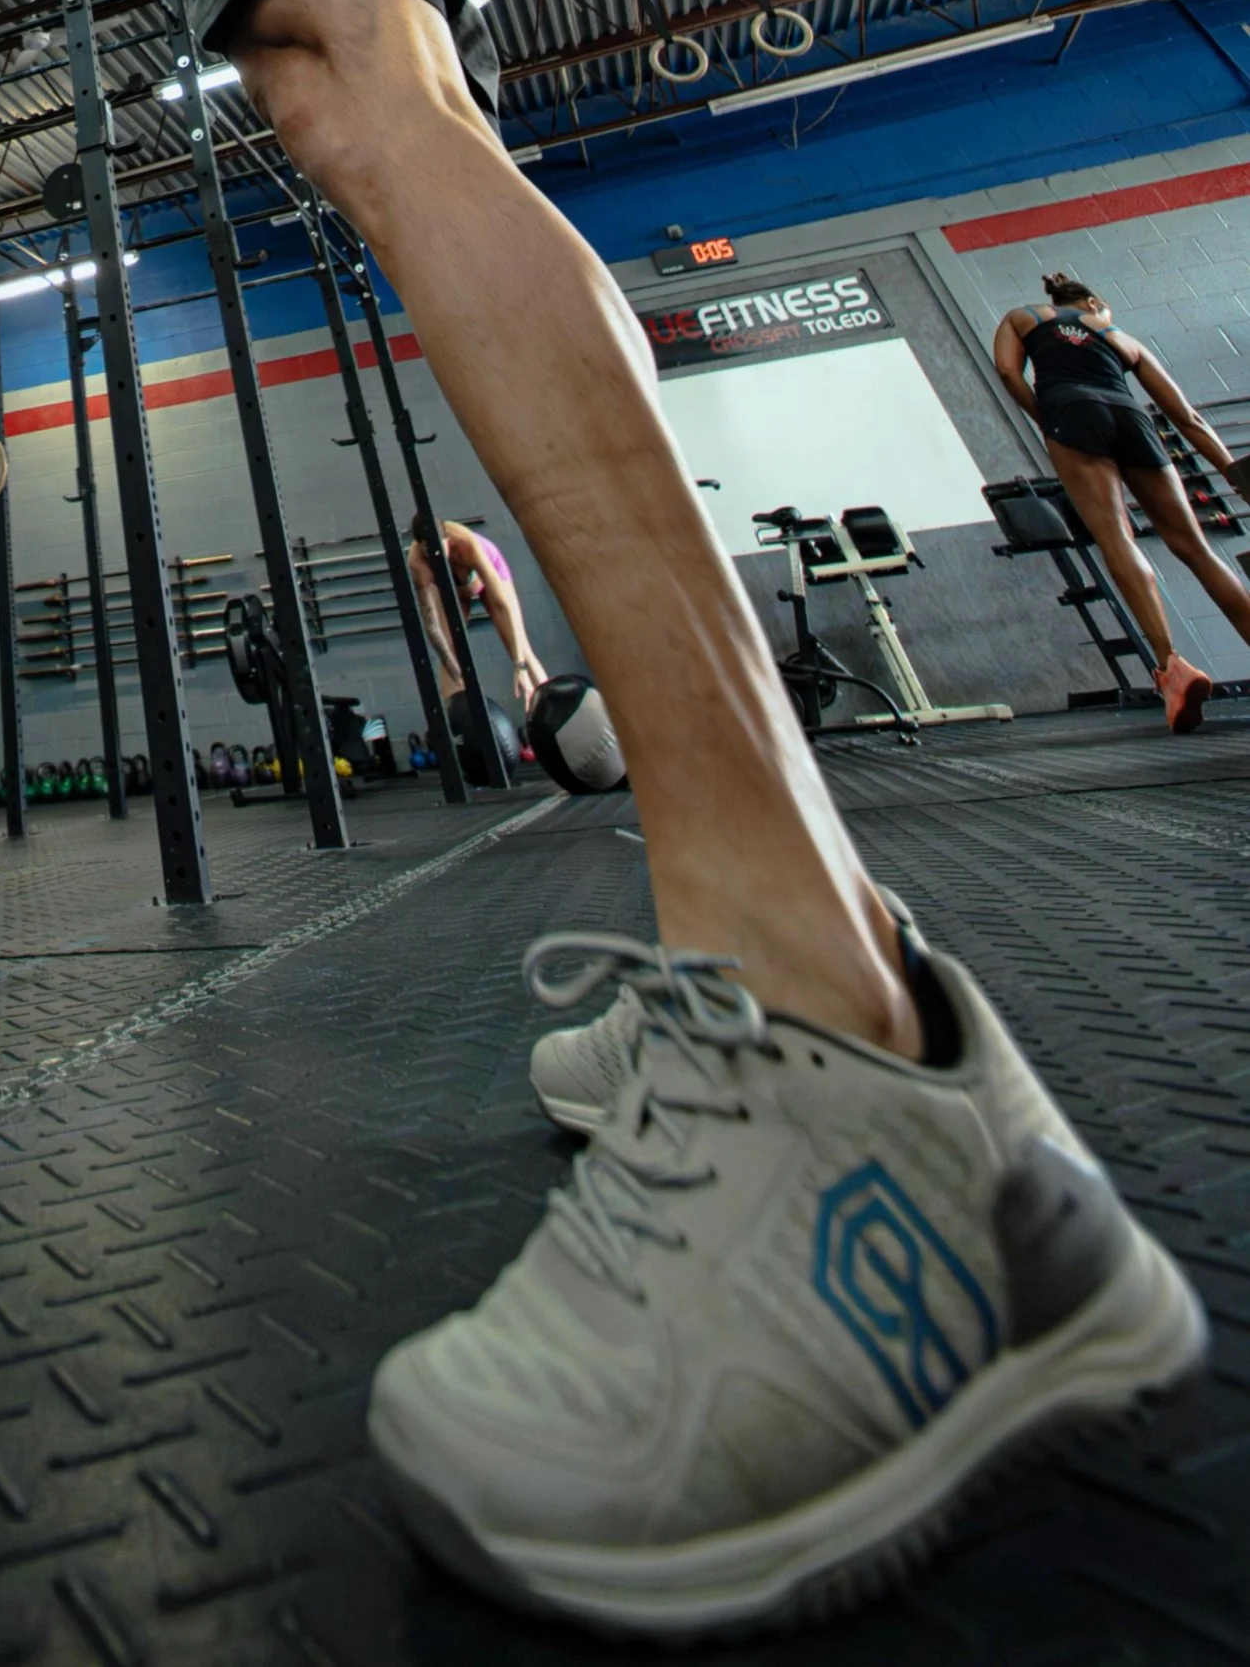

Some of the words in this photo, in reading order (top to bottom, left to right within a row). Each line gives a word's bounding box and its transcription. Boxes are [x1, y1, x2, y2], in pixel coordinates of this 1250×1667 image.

[691, 238, 735, 264] 0:05
[710, 324, 801, 354] CROSSFIT
[802, 308, 881, 335] TOLEDO
